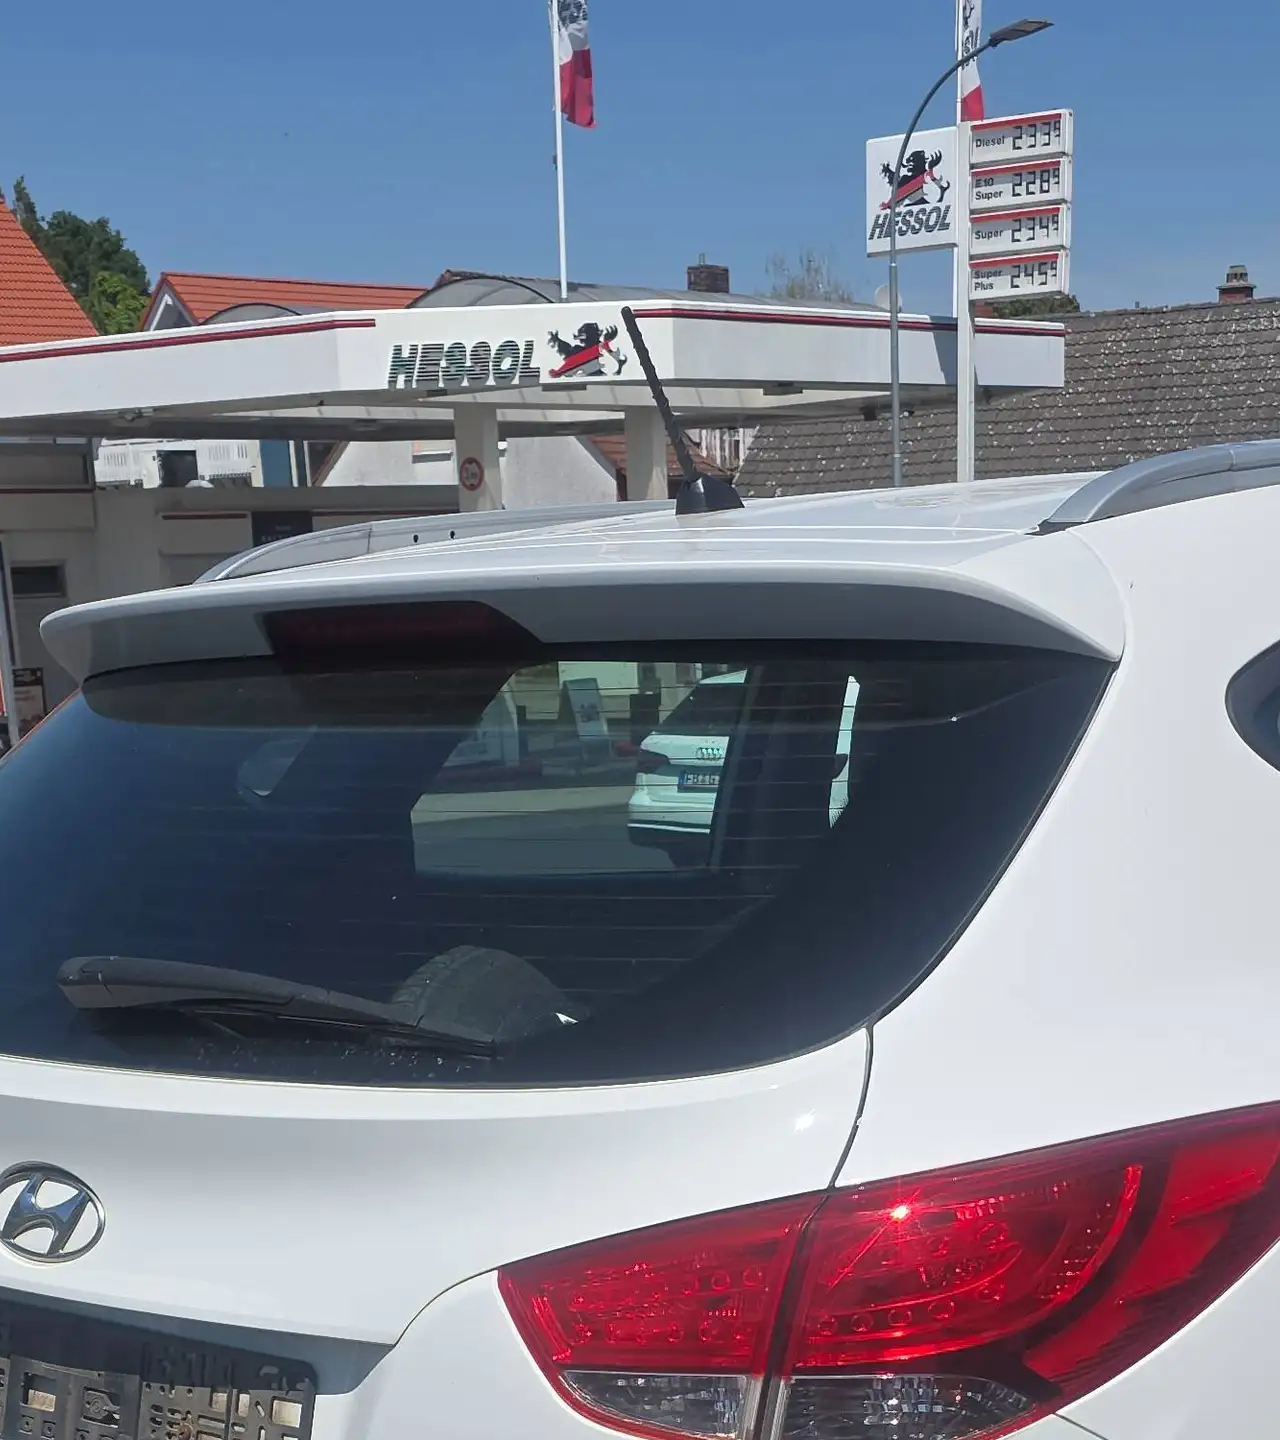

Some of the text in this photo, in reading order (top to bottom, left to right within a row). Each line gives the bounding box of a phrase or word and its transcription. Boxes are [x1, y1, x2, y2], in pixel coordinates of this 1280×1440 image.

[975, 136, 1005, 148] Diesel
[975, 177, 994, 188] E10
[975, 190, 1003, 201] Super
[975, 230, 1004, 242] Super
[974, 270, 1003, 280] Super
[974, 282, 994, 291] Plus
[388, 340, 540, 385] HESSOL
